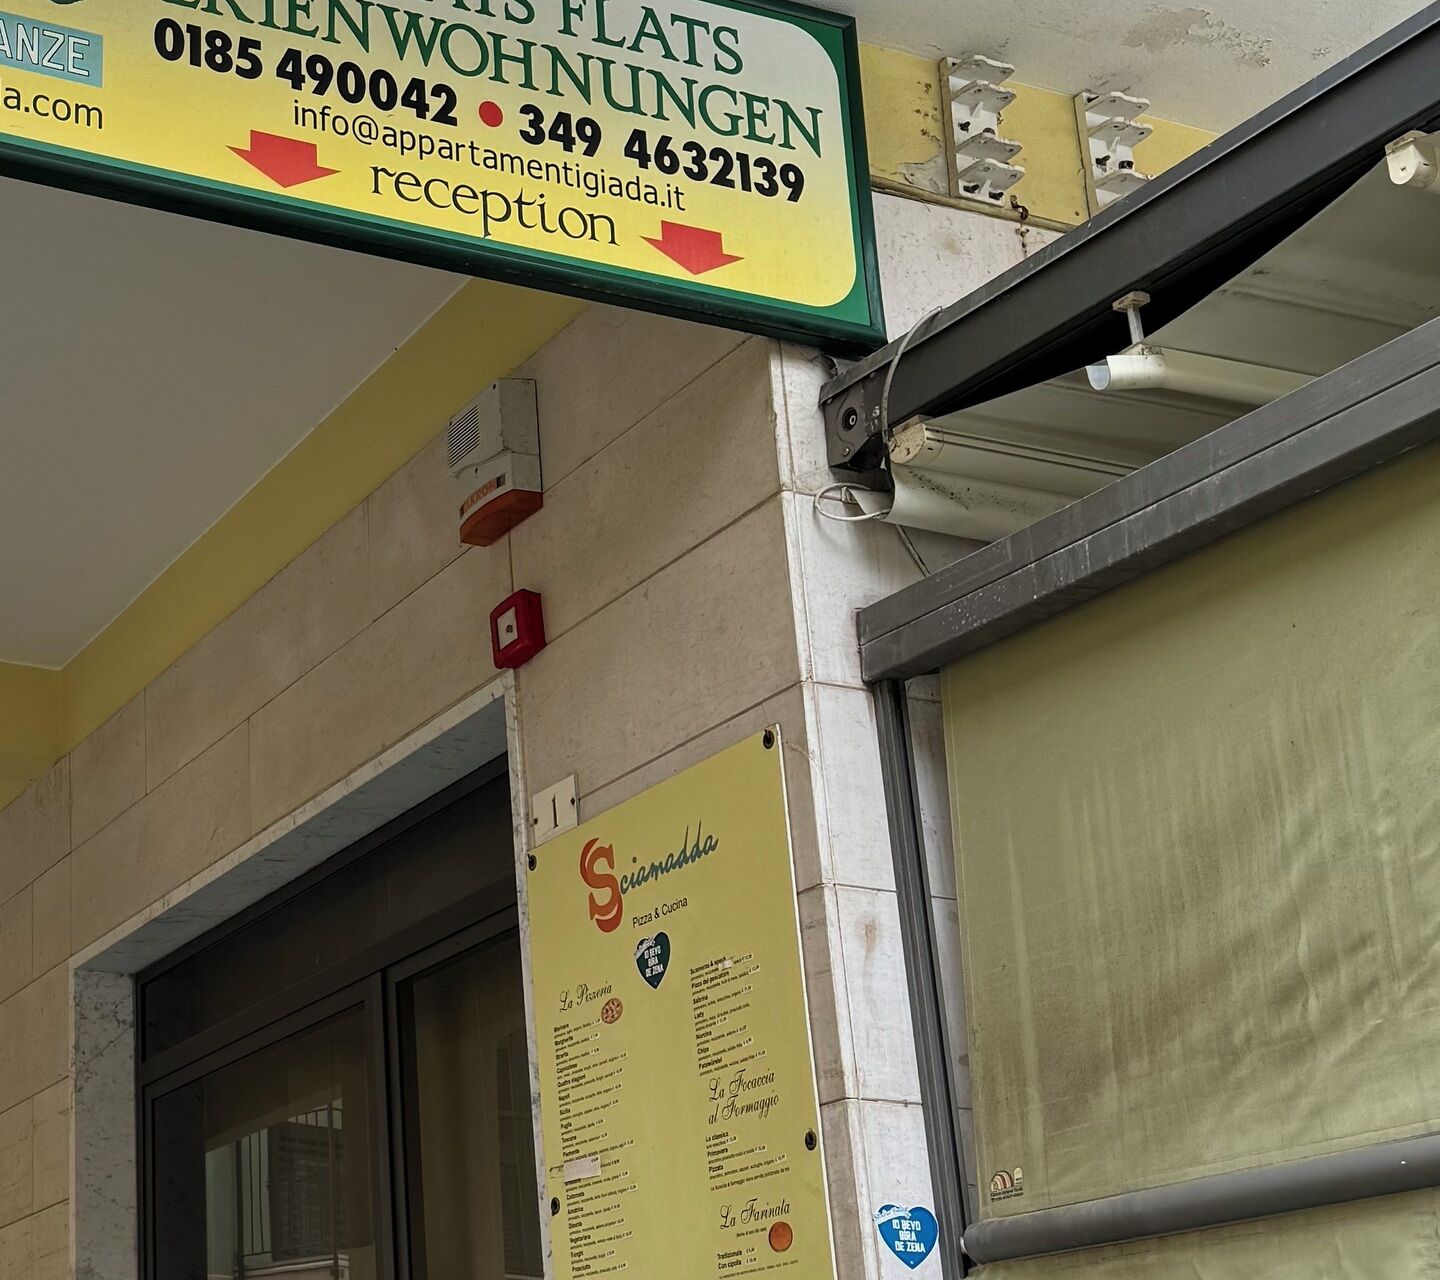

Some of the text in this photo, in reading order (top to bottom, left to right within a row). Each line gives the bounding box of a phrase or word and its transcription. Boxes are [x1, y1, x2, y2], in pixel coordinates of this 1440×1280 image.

[155, 18, 805, 203] 0185 490042 349 4632139
[293, 100, 686, 212] info@appartamentigiada.it
[369, 163, 618, 247] reception
[551, 793, 559, 829] 1
[580, 819, 719, 933] Sciamadda
[632, 896, 688, 928] Pizza & Cucina
[560, 981, 612, 1013] La Pizzeria
[709, 1068, 775, 1101] La Focaccia
[708, 1090, 779, 1125] al Formaggio
[720, 1198, 791, 1229] La Farinata
[892, 1219, 921, 1231] IO BEVO
[895, 1241, 926, 1253] DE ZENA
